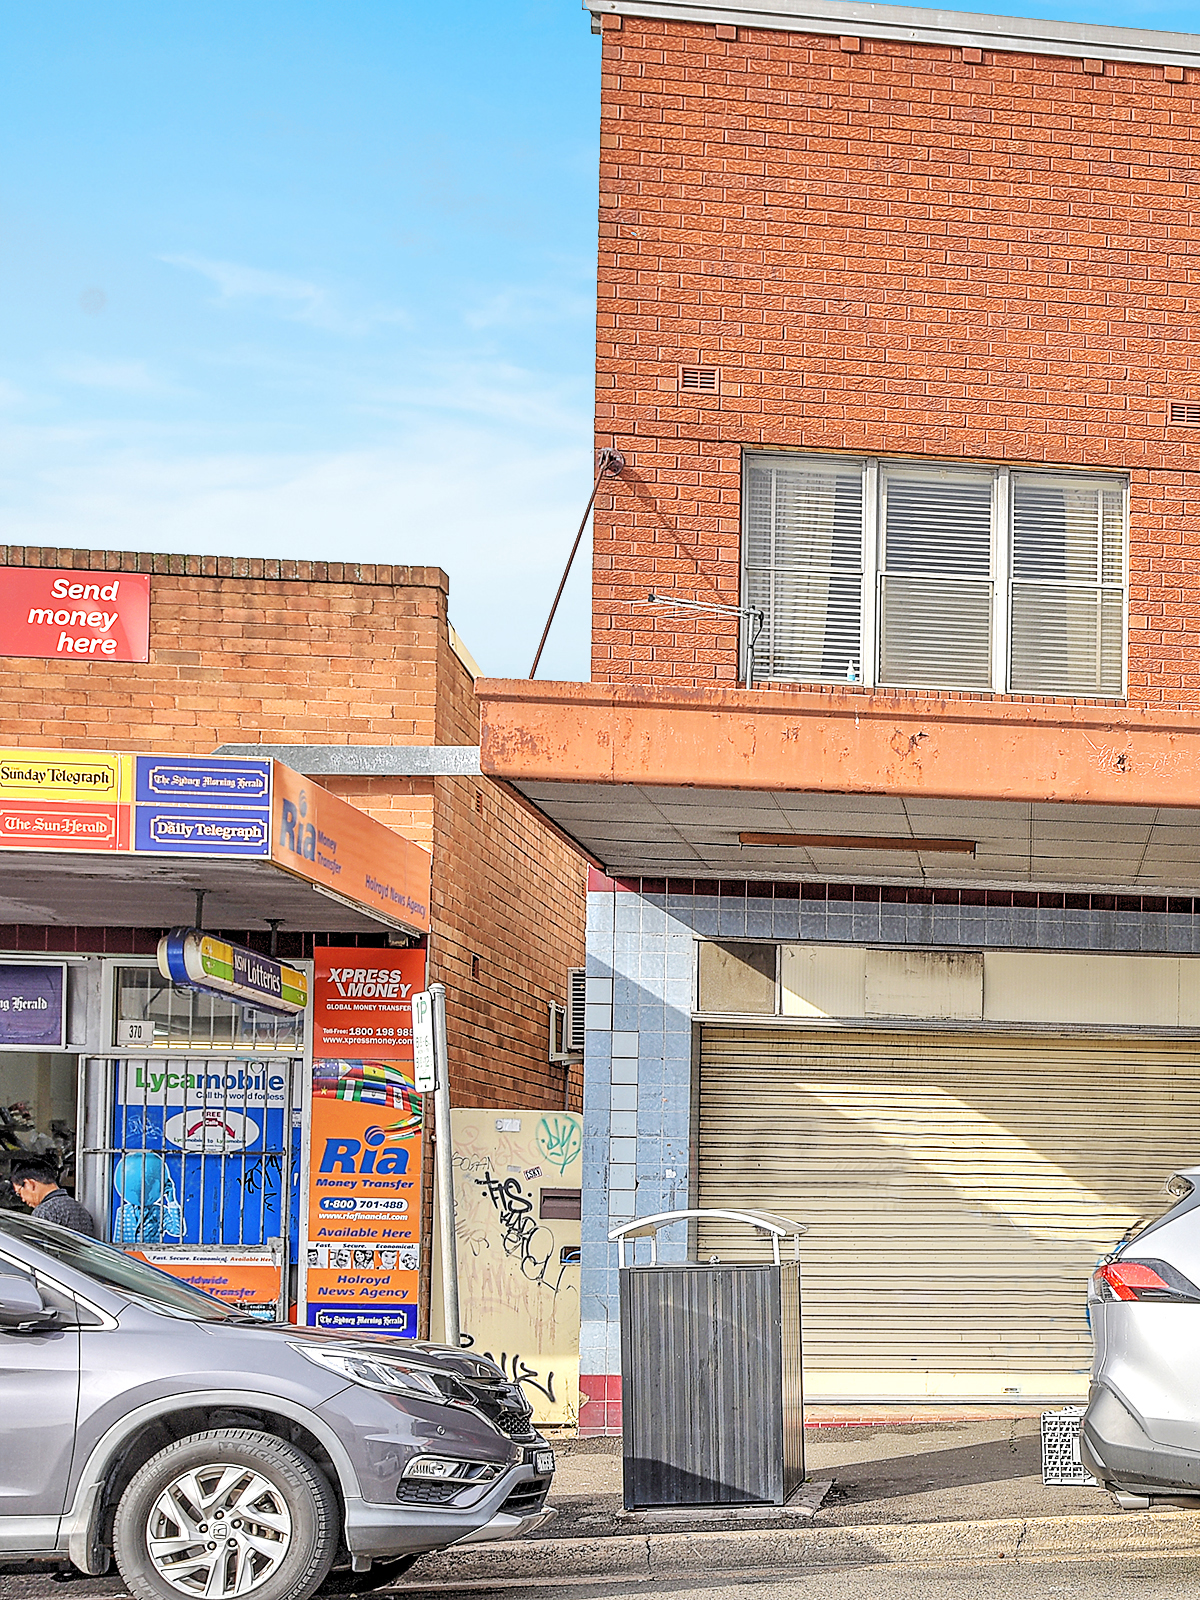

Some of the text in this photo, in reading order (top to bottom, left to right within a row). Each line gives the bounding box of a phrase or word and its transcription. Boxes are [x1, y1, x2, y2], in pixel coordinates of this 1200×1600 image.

[51, 578, 119, 601] Send
[28, 608, 118, 632] money
[57, 631, 117, 654] here
[1, 766, 109, 785] Sunday Telegraph
[154, 775, 263, 789] The Sydney Morning Herald
[5, 816, 108, 835] The Sun-Herald
[157, 822, 262, 840] Daily Telegraph
[280, 789, 317, 862] Ria
[317, 830, 337, 854] Money
[317, 851, 342, 875] Transfer
[365, 874, 426, 919] Holroyd News Agency
[234, 954, 281, 993] NSW Lotteries
[327, 968, 402, 984] XPRESS
[347, 982, 412, 998] MONEY
[12, 997, 48, 1012] Herald
[378, 1004, 412, 1012] TRANSFER
[129, 1025, 142, 1038] 370
[348, 1027, 374, 1036] 1800
[375, 1028, 395, 1036] 198
[136, 1064, 285, 1093] Lycamobile
[229, 1092, 252, 1100] word
[319, 1125, 410, 1175] Ria
[316, 1178, 414, 1190] Money Transfer
[323, 1199, 404, 1209] 1-800 701-488
[319, 1212, 408, 1222] www.riafinancial.com
[317, 1227, 412, 1238] Available Here
[177, 1275, 229, 1285] orldwide
[337, 1275, 390, 1286] Holroyd
[208, 1288, 256, 1298] Transfer
[318, 1287, 409, 1299] News Agency
[320, 1315, 403, 1326] The Sydney Morning Herald
[236, 1443, 300, 1488] MICHELIN
